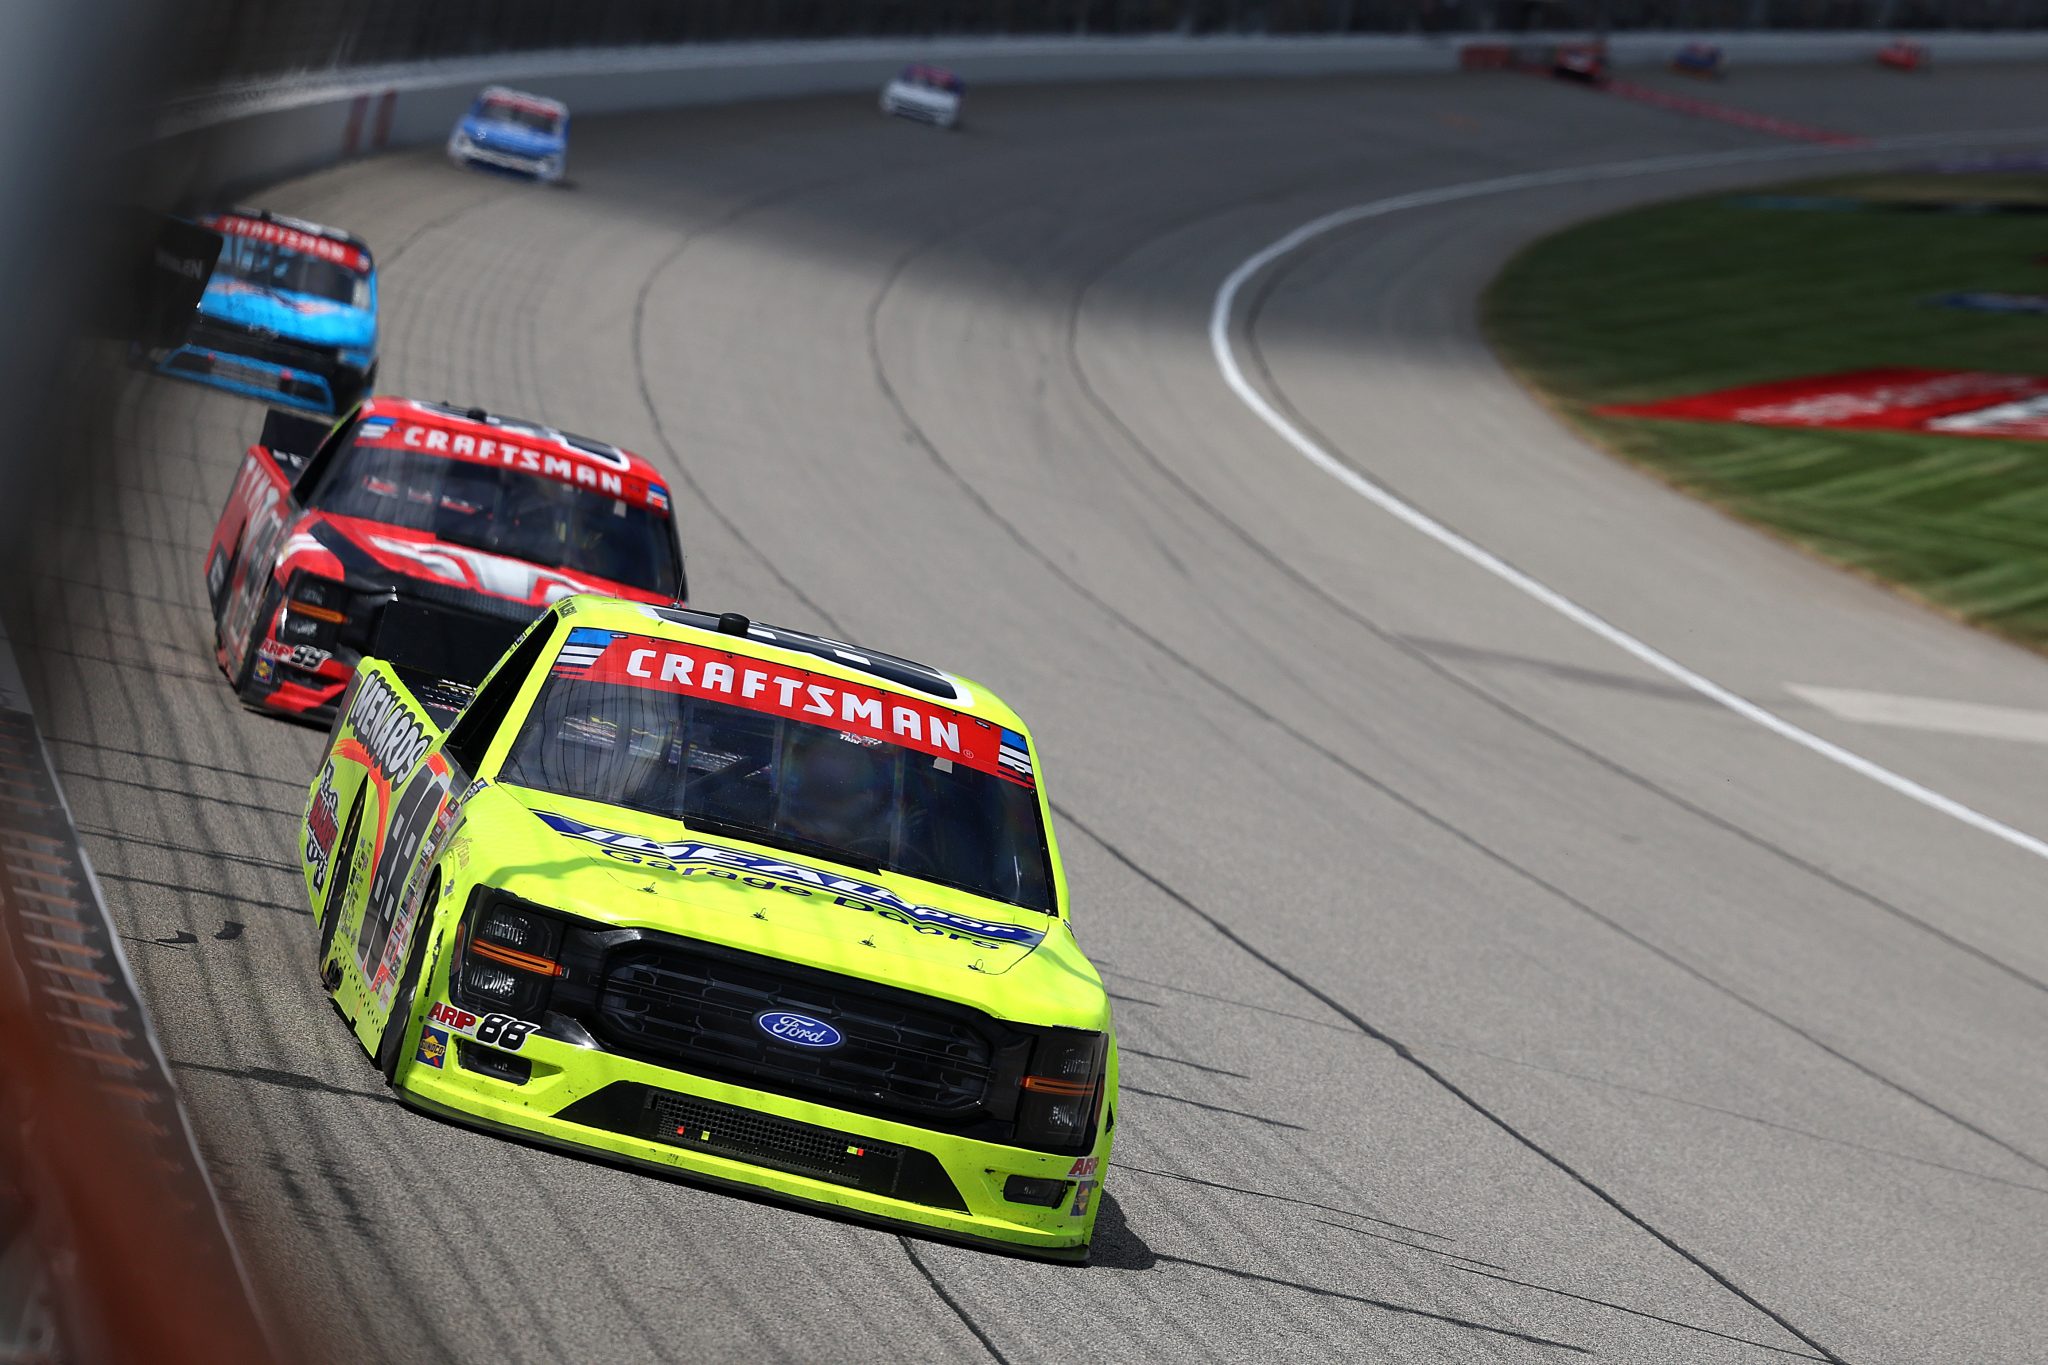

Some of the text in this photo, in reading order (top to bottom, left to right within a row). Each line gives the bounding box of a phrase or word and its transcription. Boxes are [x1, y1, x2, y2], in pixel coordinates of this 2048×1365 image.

[404, 426, 622, 496] CRAFTSMAN
[350, 672, 430, 785] MENARDS
[626, 648, 961, 753] CRAFTSMAN
[575, 829, 881, 901] IDEAL
[601, 848, 1000, 950] Garage Doors
[427, 1002, 477, 1030] ARP
[476, 1013, 541, 1052] 88
[772, 1016, 827, 1043] Ford
[1068, 1156, 1099, 1176] ARP
